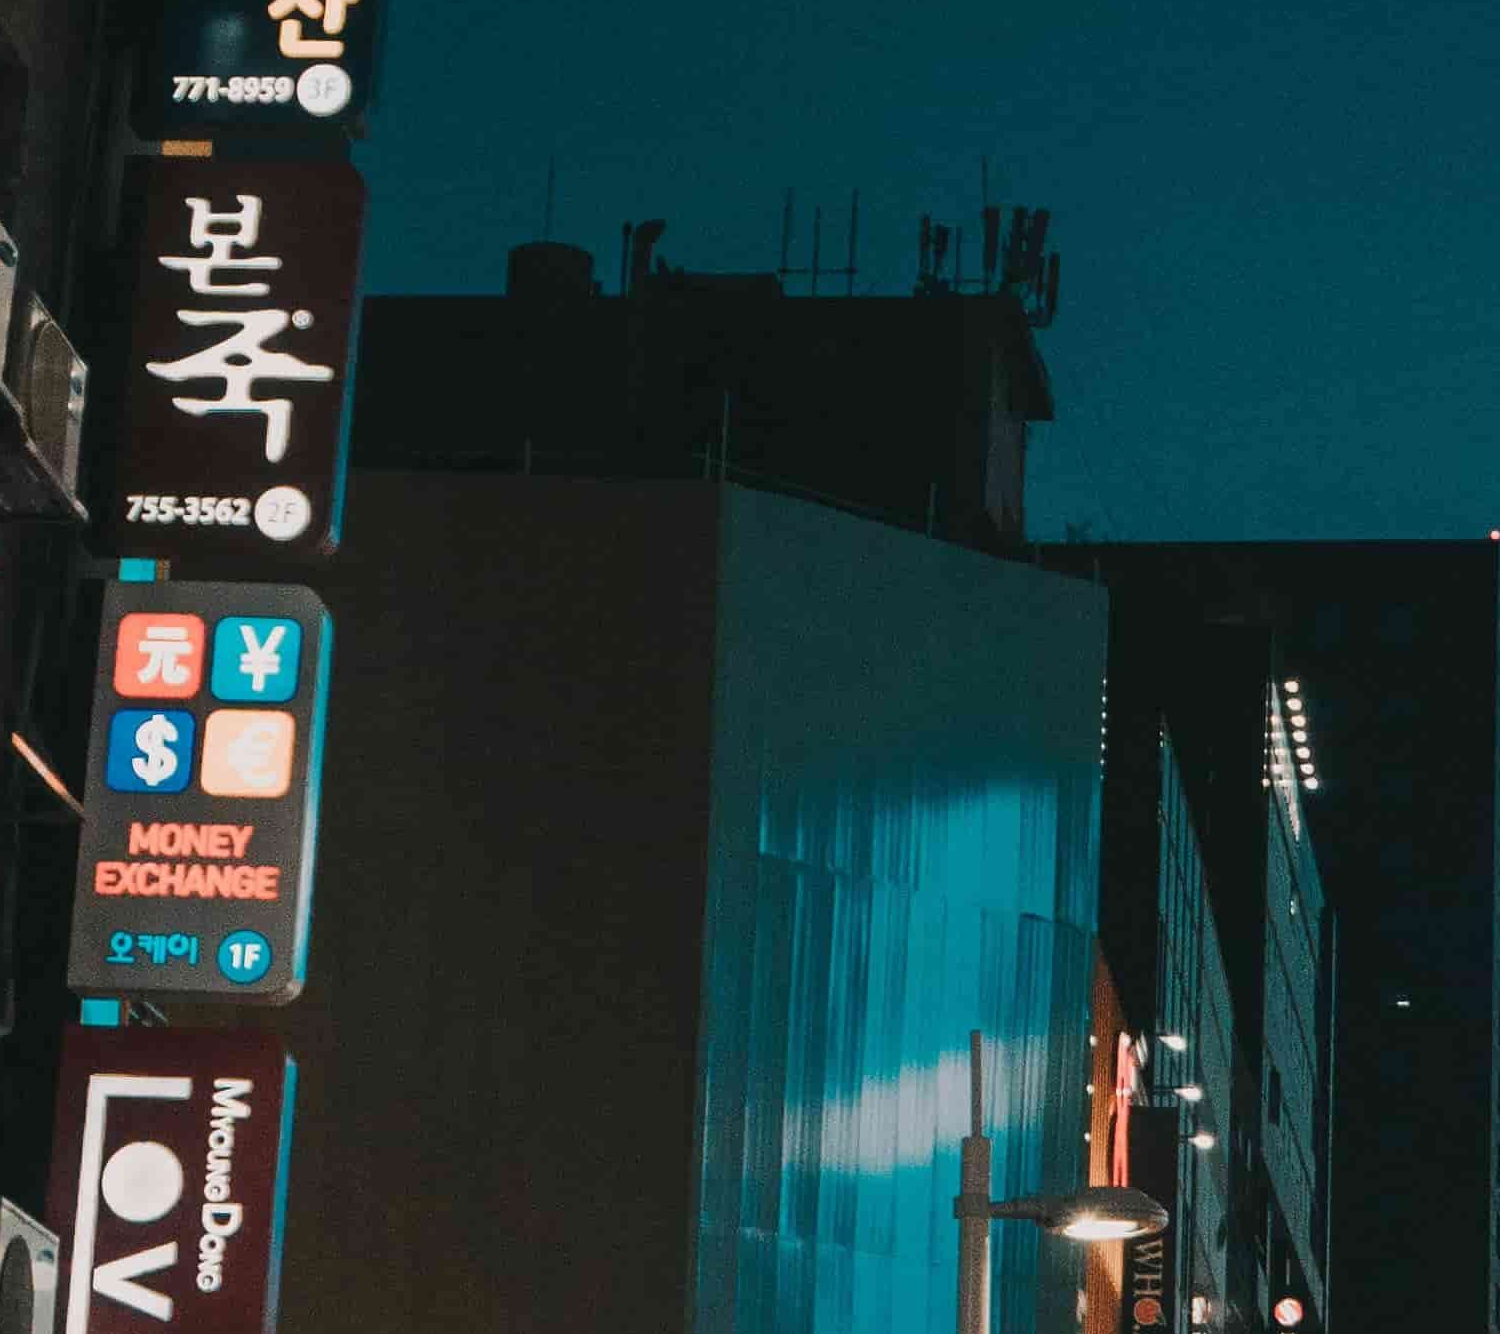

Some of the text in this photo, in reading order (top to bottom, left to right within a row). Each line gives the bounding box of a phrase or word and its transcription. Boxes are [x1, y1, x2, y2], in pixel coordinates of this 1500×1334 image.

[172, 75, 295, 103] 771-8959
[145, 195, 335, 464] 본죽
[126, 494, 252, 527] 755-3562
[128, 821, 253, 861] MONEY
[94, 861, 281, 902] EXCHANGE
[106, 931, 262, 972] 오케이 1F
